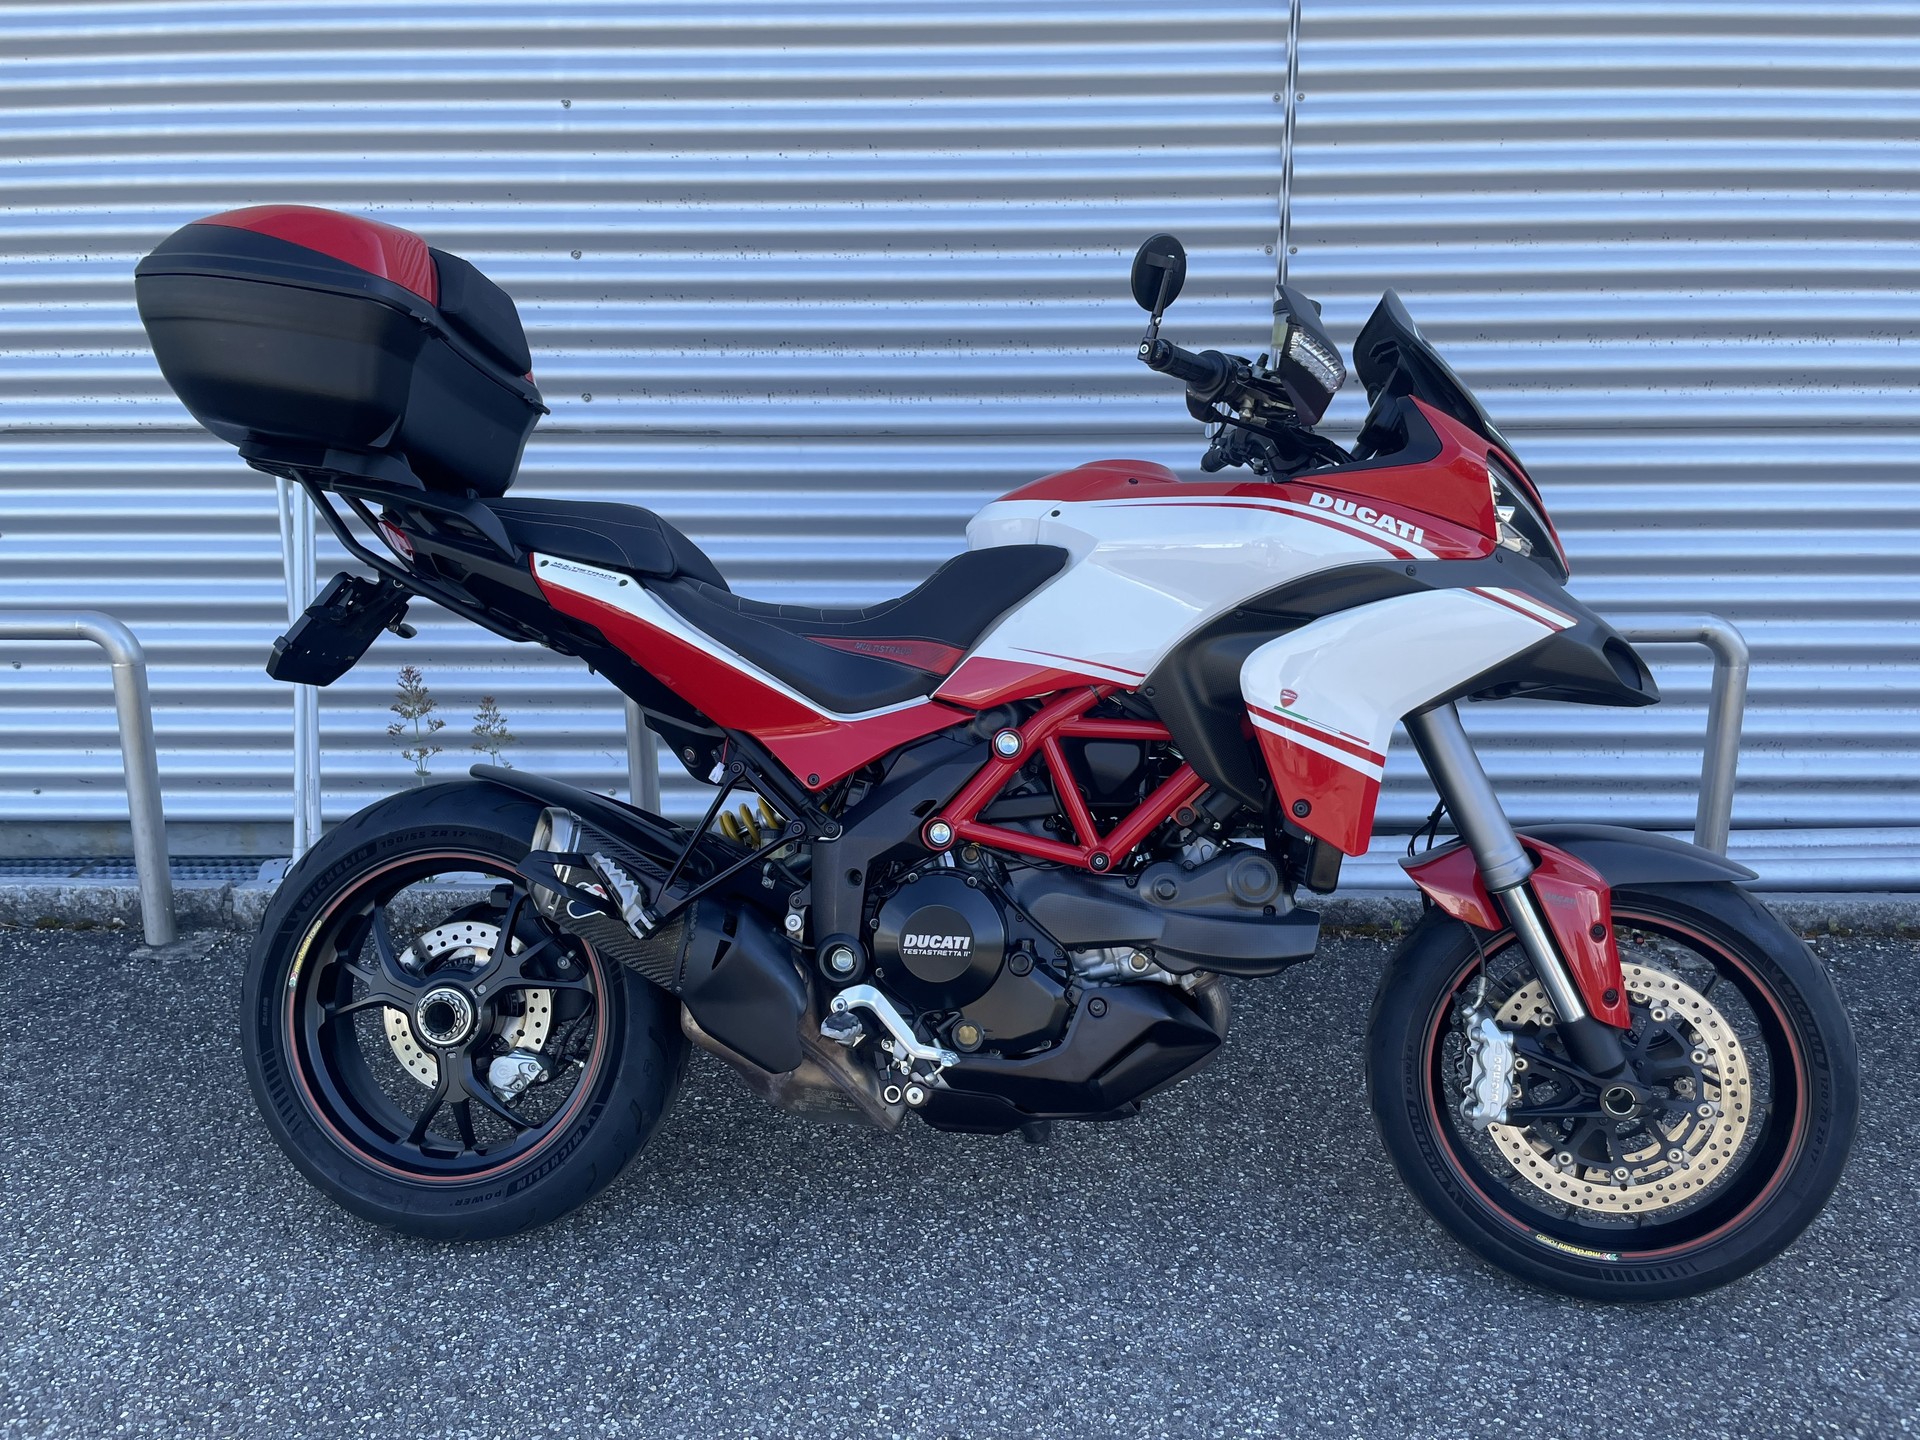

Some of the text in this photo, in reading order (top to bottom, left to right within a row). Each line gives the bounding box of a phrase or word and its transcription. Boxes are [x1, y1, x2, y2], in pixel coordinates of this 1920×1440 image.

[1309, 491, 1424, 544] DUCATI
[301, 847, 369, 906] MICHELIN
[902, 948, 962, 956] TESTASTRETTA
[903, 934, 971, 949] DUCATI
[1782, 983, 1826, 1064] MICHELIN
[1488, 1056, 1502, 1103] brembo
[1409, 1105, 1448, 1183] MICHELIN
[1810, 1077, 1829, 1162] 120/70 ZR 17
[515, 1128, 584, 1191] MICHELIN
[1557, 1242, 1601, 1258] marchesini
